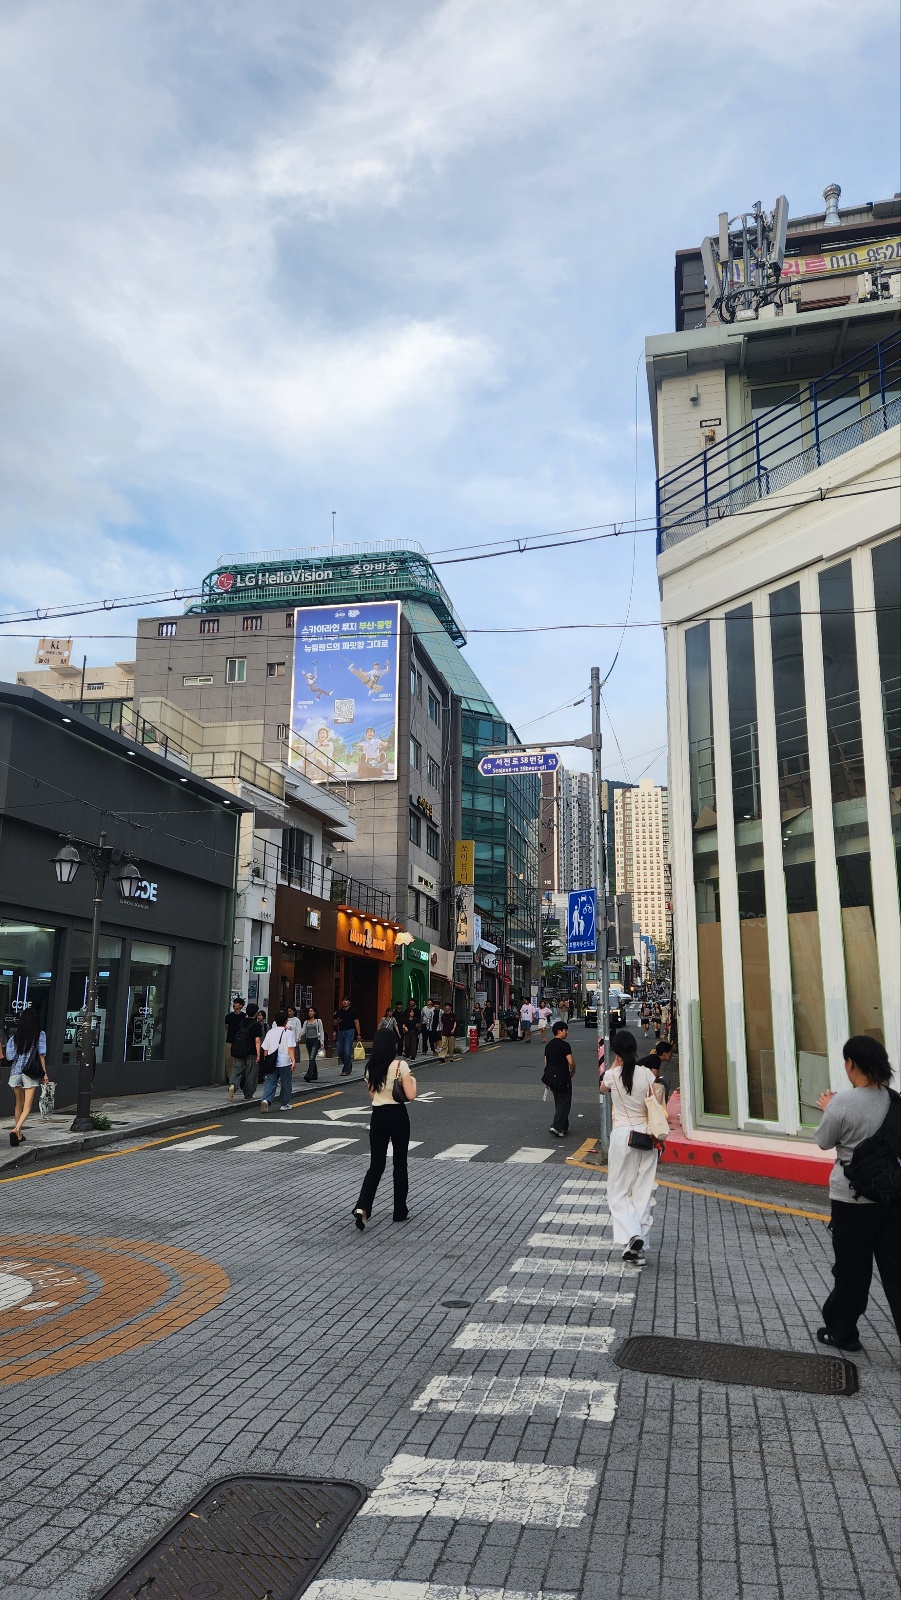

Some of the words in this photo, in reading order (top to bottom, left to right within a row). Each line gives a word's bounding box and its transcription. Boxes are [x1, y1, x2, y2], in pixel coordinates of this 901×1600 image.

[350, 562, 399, 578] 중앙방송
[236, 574, 255, 587] LG
[258, 569, 333, 585] HelloVision
[301, 623, 340, 634] 스카이라인
[341, 622, 357, 632] 루지
[366, 639, 389, 649] 그대로
